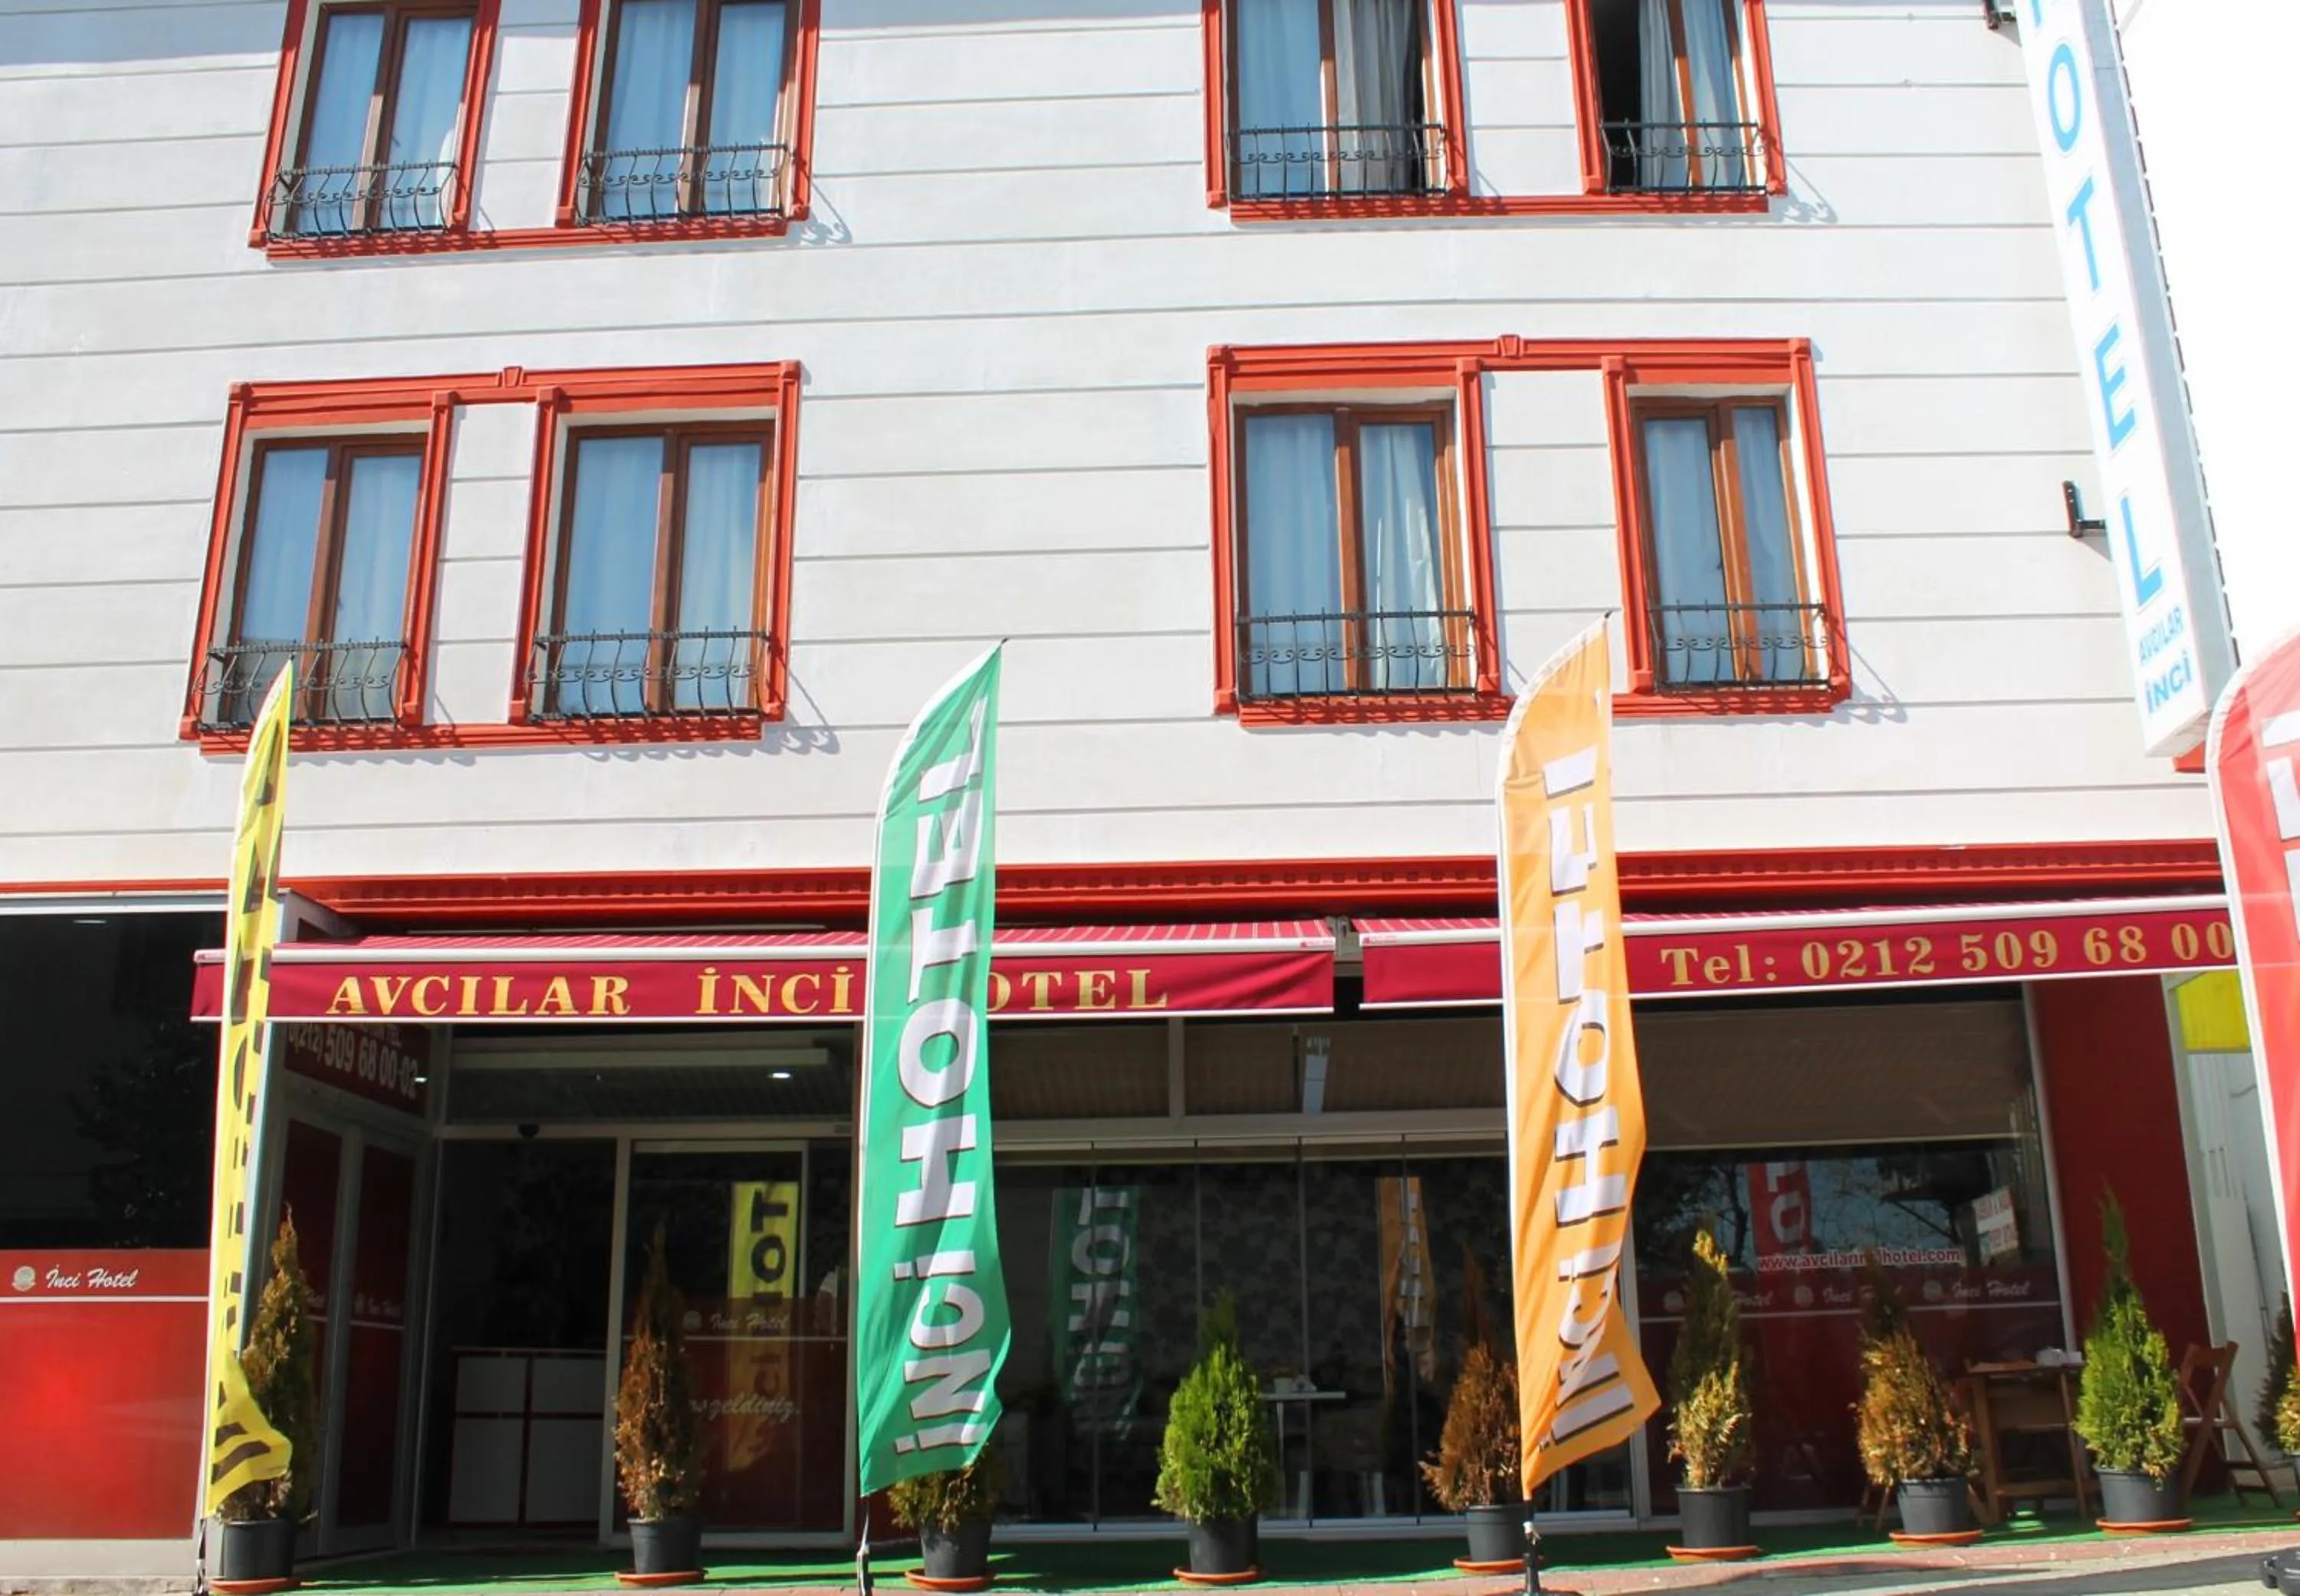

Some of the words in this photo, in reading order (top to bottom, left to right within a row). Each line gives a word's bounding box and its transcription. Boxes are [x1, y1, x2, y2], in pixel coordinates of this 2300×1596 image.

[2031, 0, 2163, 606] OTEL
[2139, 606, 2183, 665] AVCILAR
[2145, 649, 2192, 714] İNCİ
[896, 696, 989, 1227] HOTEL
[1660, 944, 1777, 986] Tel:
[1801, 936, 1936, 980] 0212
[1960, 930, 2058, 971] 509
[2083, 925, 2147, 966] 68
[2170, 921, 2234, 961] 00
[326, 975, 631, 1016] AVCILAR
[694, 965, 855, 1014] İNCİ
[986, 968, 1168, 1013] OTEL
[324, 1023, 356, 1072] 509
[358, 1037, 378, 1082] 68
[87, 1267, 139, 1288] Hotel
